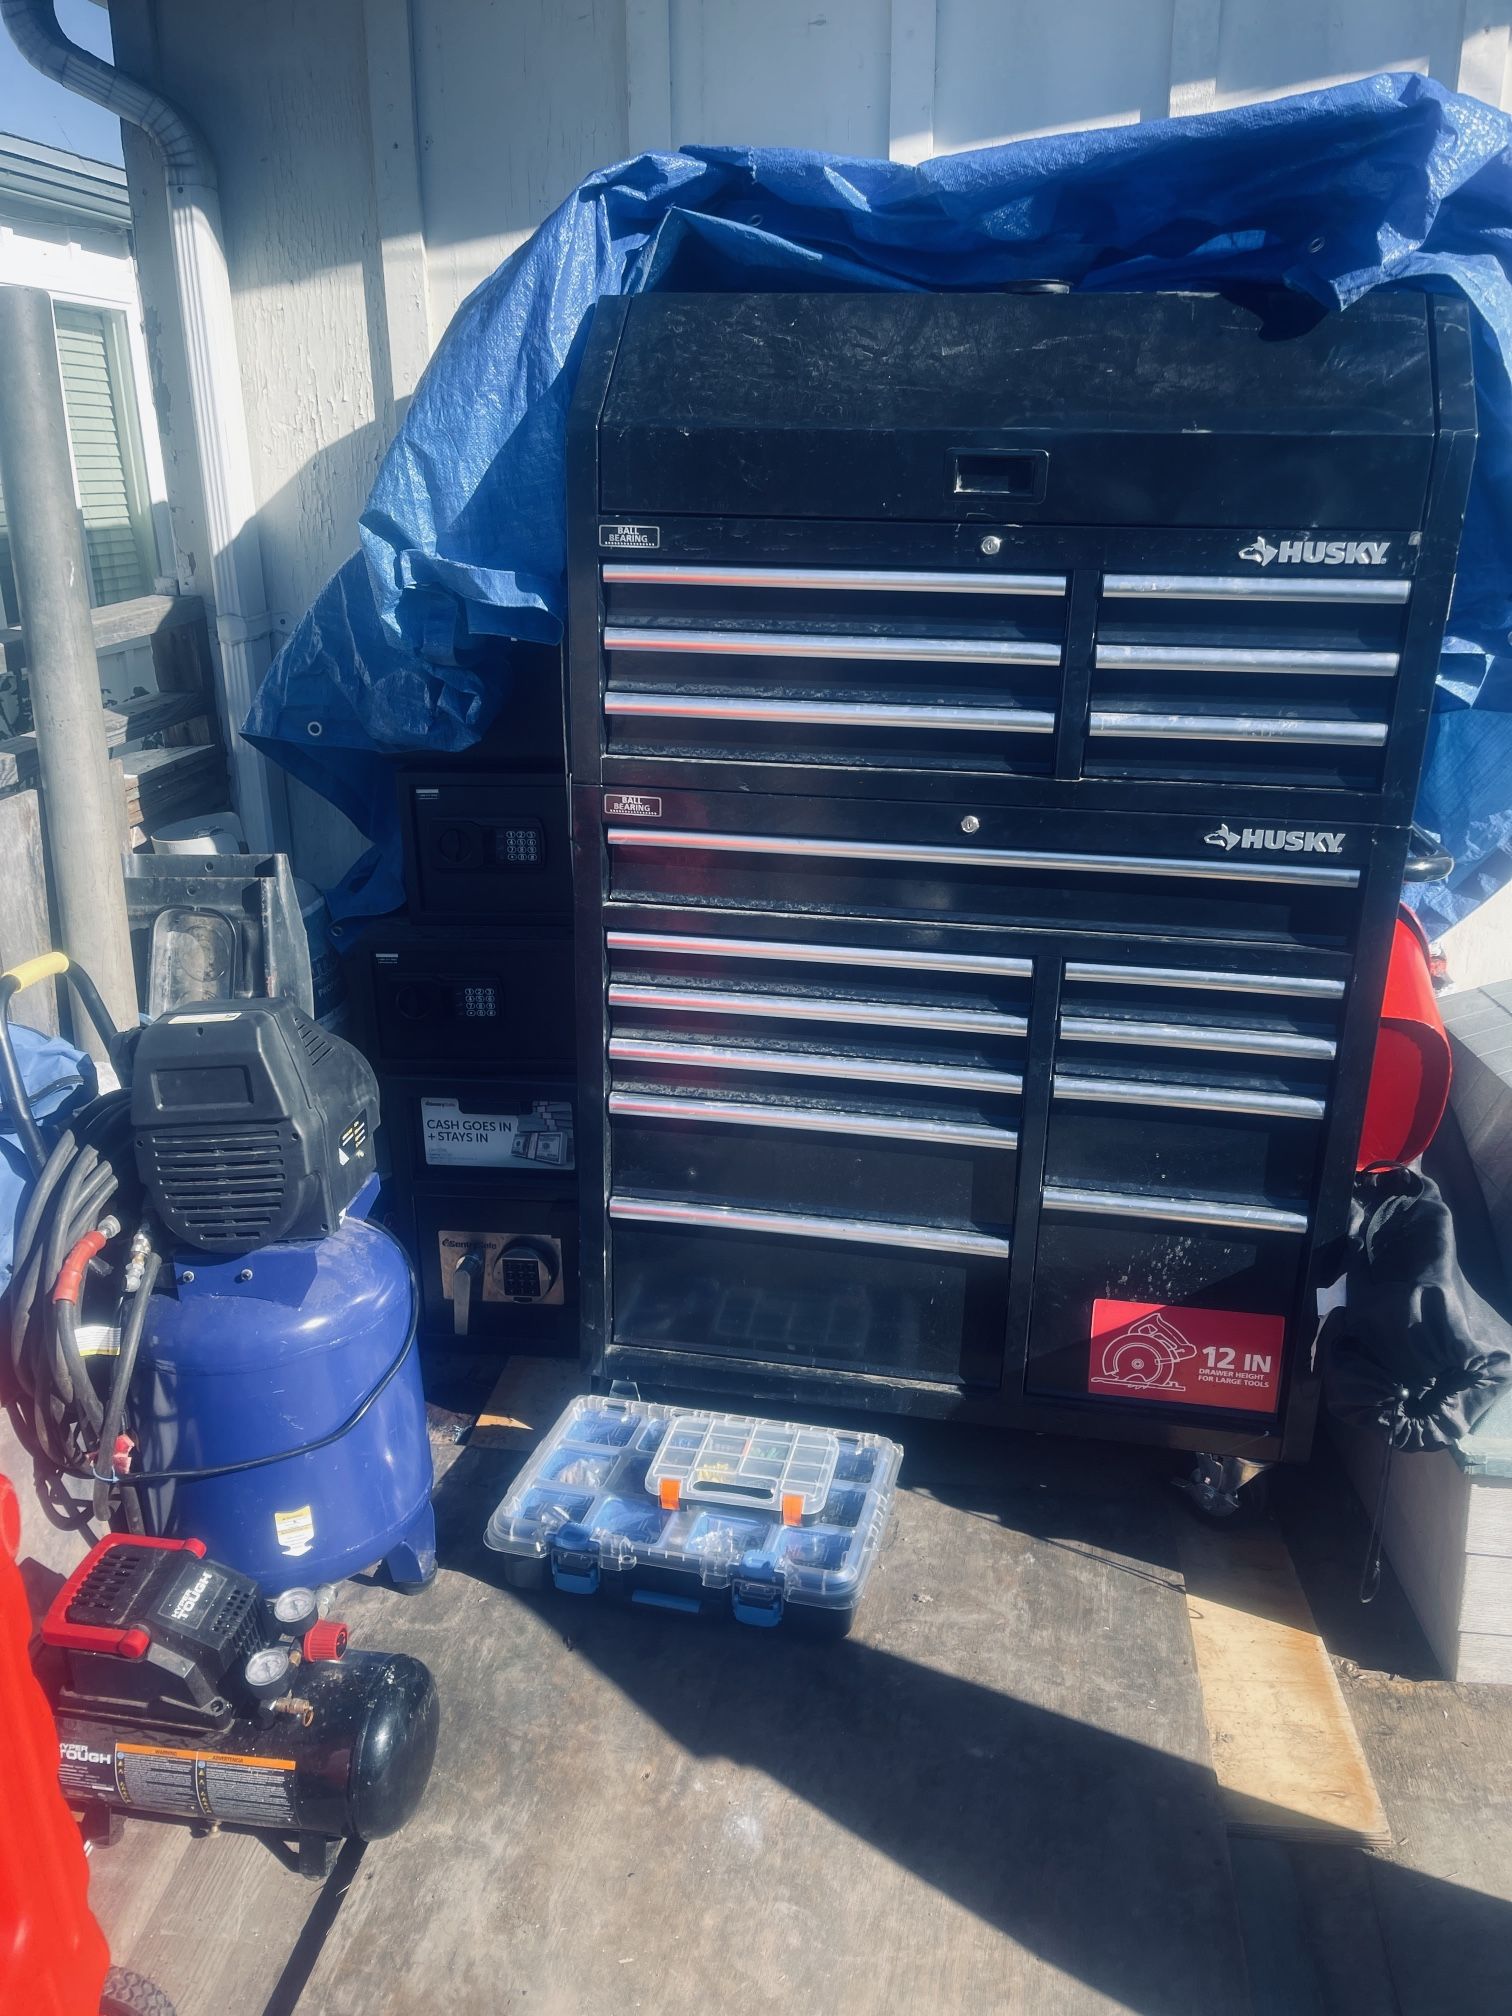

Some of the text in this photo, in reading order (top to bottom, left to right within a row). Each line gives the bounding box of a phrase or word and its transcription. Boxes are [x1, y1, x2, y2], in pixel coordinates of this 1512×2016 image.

[608, 534, 648, 542] BEARING
[1277, 540, 1391, 565] HUSKY
[621, 796, 643, 804] BALL
[613, 803, 651, 811] BEARING
[1240, 828, 1346, 853] HUSKY
[426, 1119, 512, 1132] CASH GOES IN
[475, 1133, 489, 1143] IN
[1202, 1346, 1272, 1373] 12 IN
[1198, 1369, 1265, 1380] DRAWER HEIGHT
[1198, 1375, 1270, 1388] FOR LARGE TOOLS
[180, 1571, 213, 1620] TOUGH
